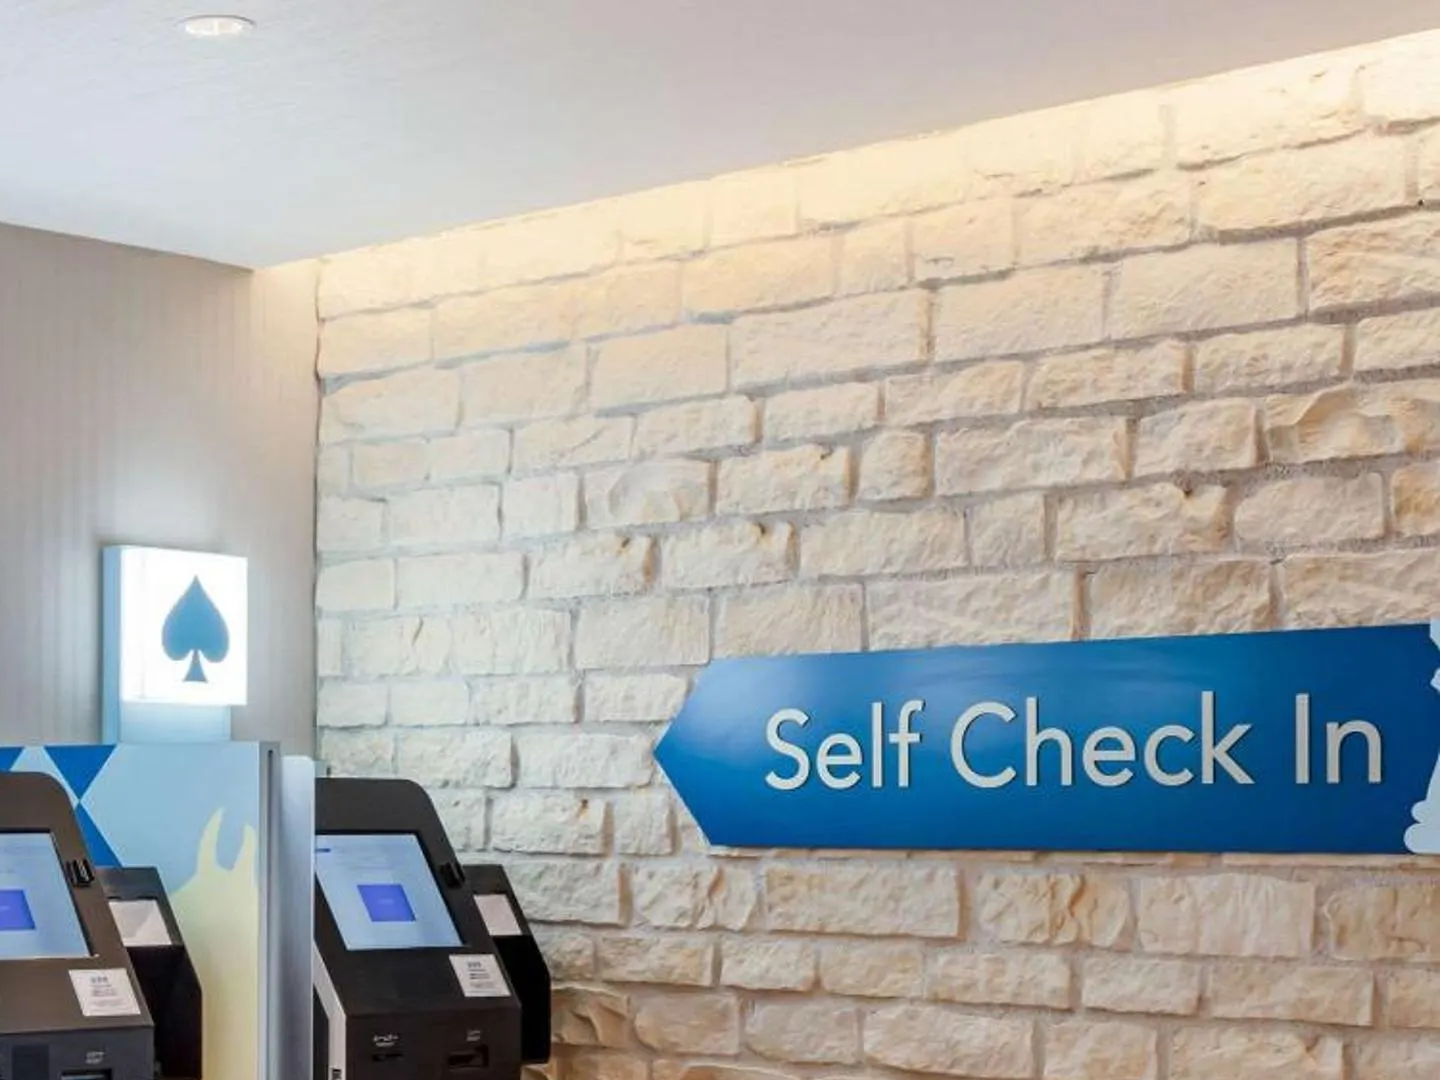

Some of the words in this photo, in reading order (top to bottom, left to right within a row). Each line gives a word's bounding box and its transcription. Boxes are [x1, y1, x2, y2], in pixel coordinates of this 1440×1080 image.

[764, 699, 925, 790] Self
[950, 691, 1255, 789] Check
[1294, 693, 1383, 785] In
